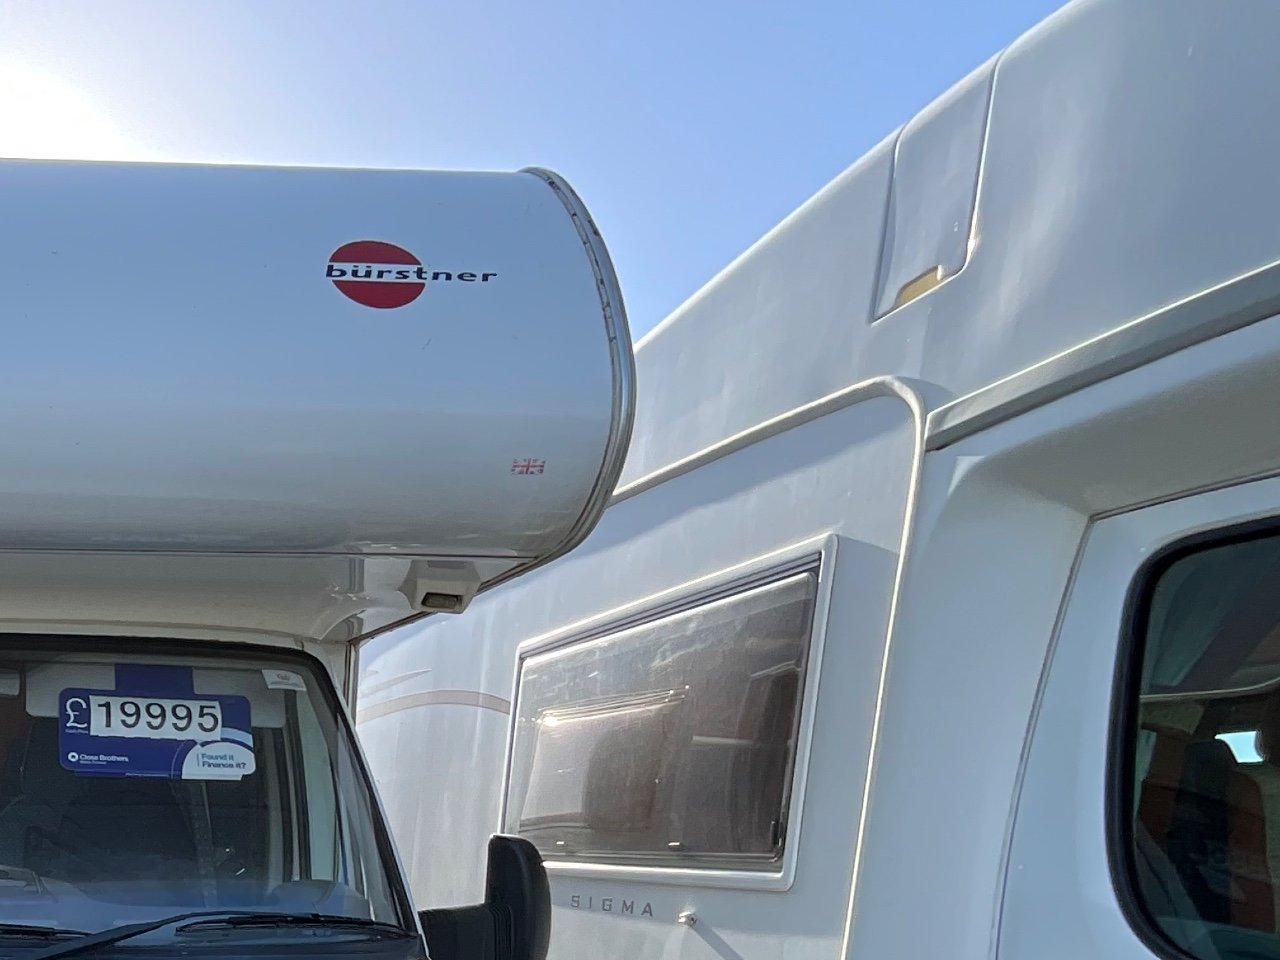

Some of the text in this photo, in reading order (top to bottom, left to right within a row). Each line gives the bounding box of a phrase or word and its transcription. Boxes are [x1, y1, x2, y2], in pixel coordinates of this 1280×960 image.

[326, 264, 498, 282] bürstner
[202, 761, 234, 769] Finance
[570, 895, 654, 917] SIGMA
